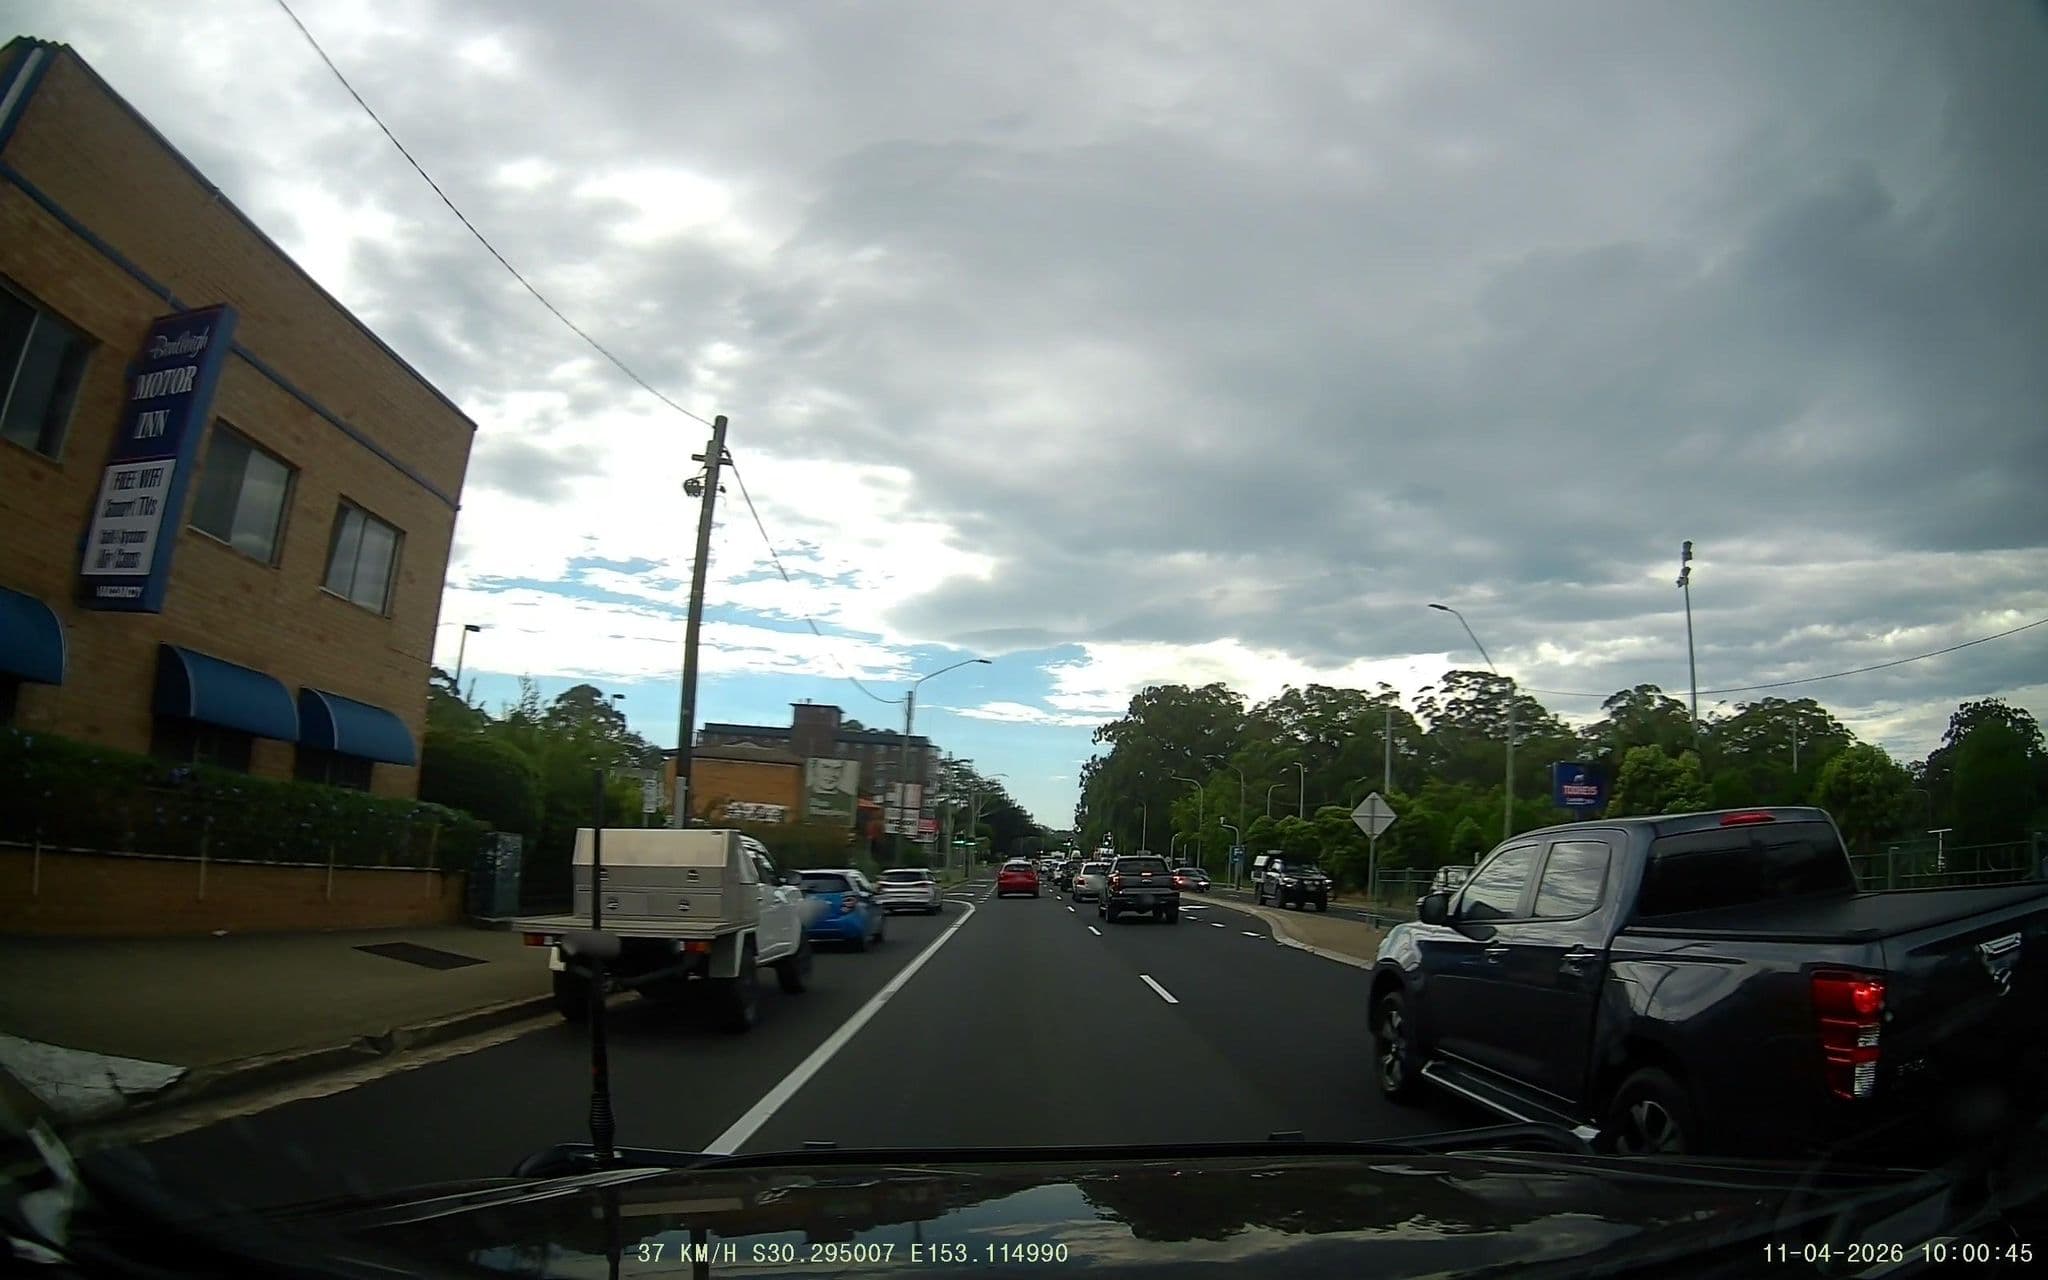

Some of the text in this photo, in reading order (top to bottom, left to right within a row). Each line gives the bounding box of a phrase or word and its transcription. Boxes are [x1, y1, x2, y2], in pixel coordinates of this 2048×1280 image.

[133, 366, 198, 400] MOTOR
[133, 409, 170, 439] INN
[113, 470, 137, 490] FREE
